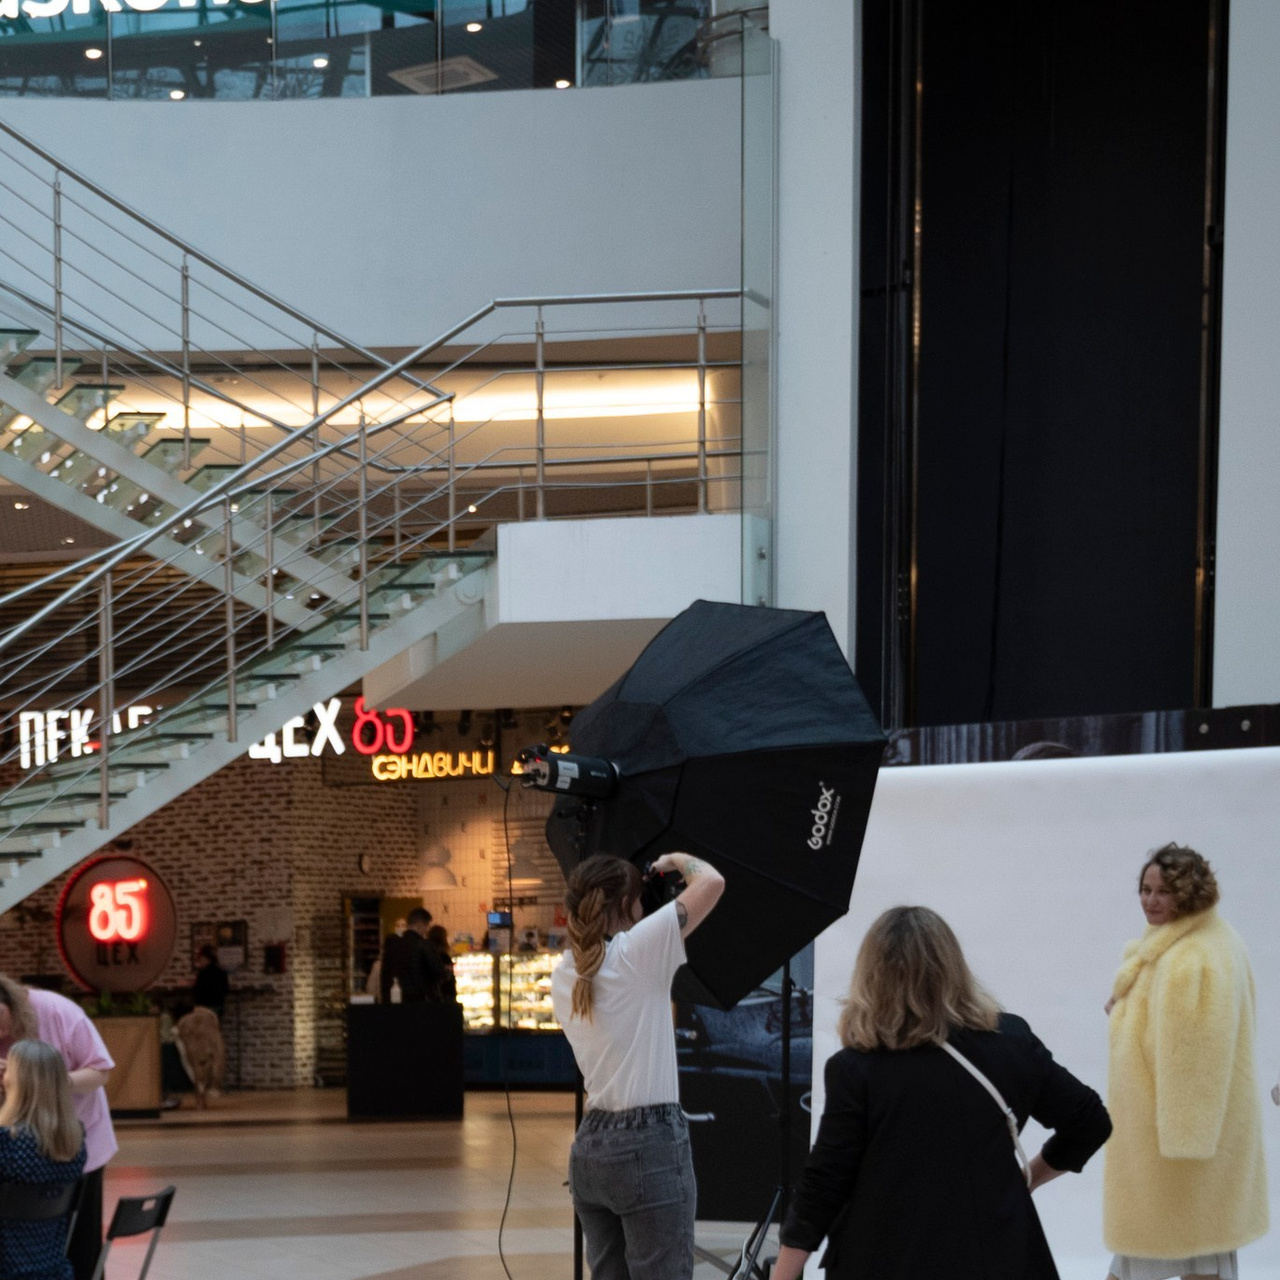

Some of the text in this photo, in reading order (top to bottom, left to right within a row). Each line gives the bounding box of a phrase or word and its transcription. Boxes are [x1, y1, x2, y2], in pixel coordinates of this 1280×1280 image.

[372, 750, 494, 780] СЭНДВИЧИ
[807, 786, 835, 850] Godox
[89, 879, 148, 940] 85
